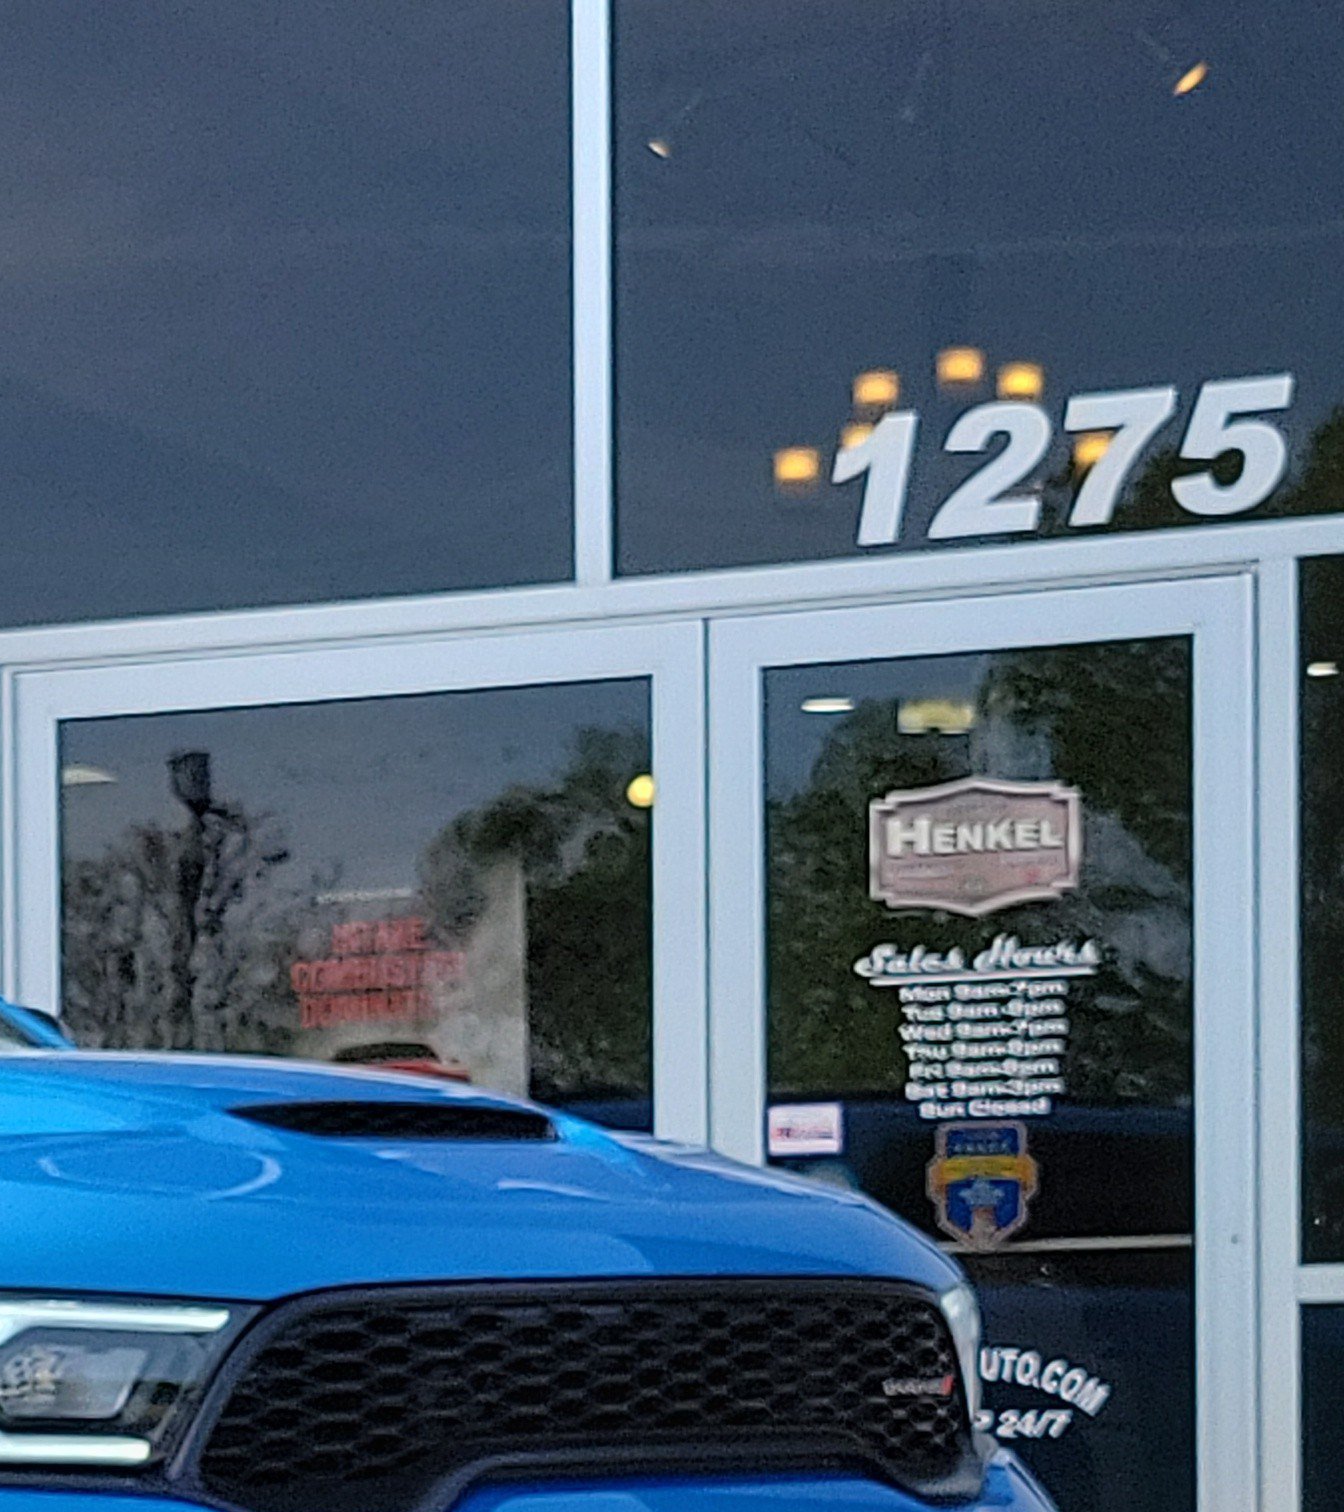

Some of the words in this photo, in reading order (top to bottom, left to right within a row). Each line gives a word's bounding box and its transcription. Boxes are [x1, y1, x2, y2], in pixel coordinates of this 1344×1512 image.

[831, 371, 1295, 547] 1275
[886, 814, 1064, 857] HENKEL
[853, 943, 964, 977] Sales
[973, 932, 1101, 972] Hours
[899, 986, 951, 1003] Mon
[898, 1023, 952, 1041] Wed
[968, 1097, 1051, 1117] Closed
[996, 1408, 1073, 1438] 24/7
